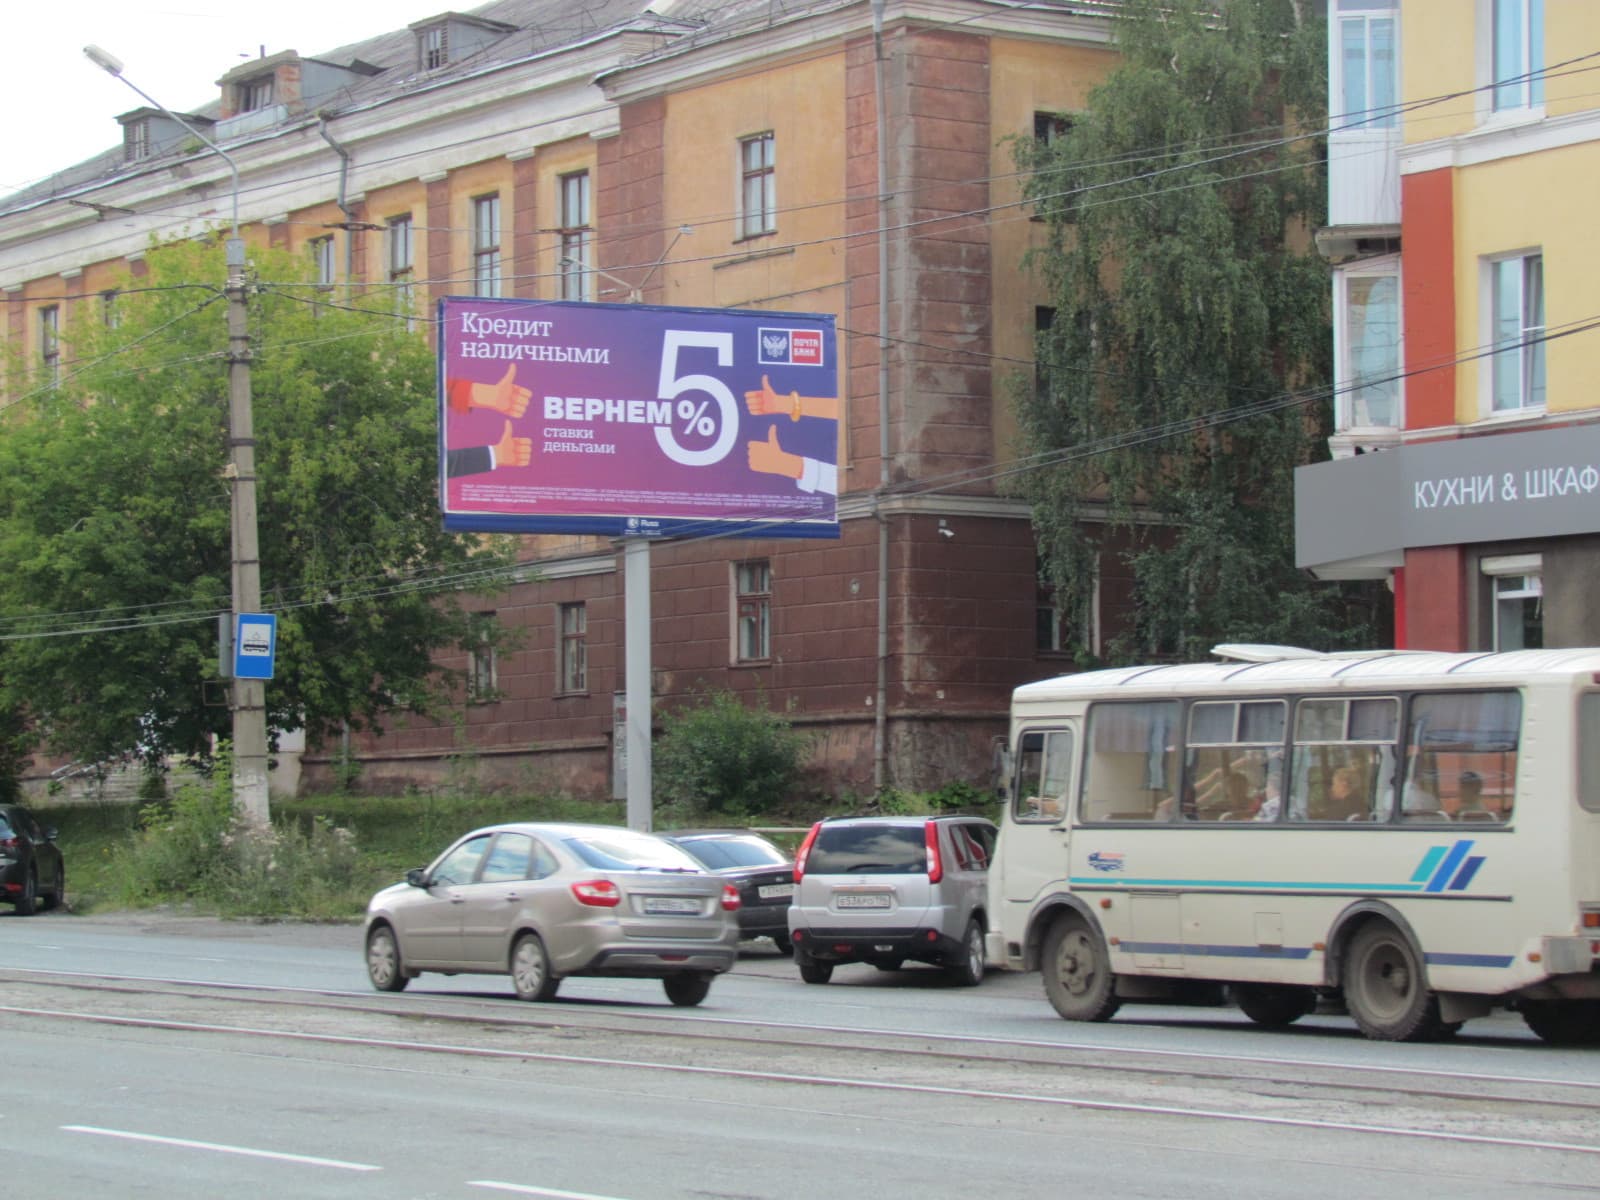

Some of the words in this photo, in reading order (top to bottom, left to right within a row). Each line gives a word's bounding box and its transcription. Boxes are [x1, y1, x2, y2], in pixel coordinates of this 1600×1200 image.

[461, 312, 553, 338] Кредит
[460, 341, 610, 364] наличными
[543, 396, 672, 425] ВЕРНЕМ
[653, 329, 739, 466] 5
[677, 399, 716, 437] %
[543, 427, 594, 439] ставки
[543, 441, 616, 454] деньгами
[1414, 474, 1494, 509] КУХНИ
[1501, 472, 1518, 501] &
[1525, 465, 1599, 499] ШКАФ
